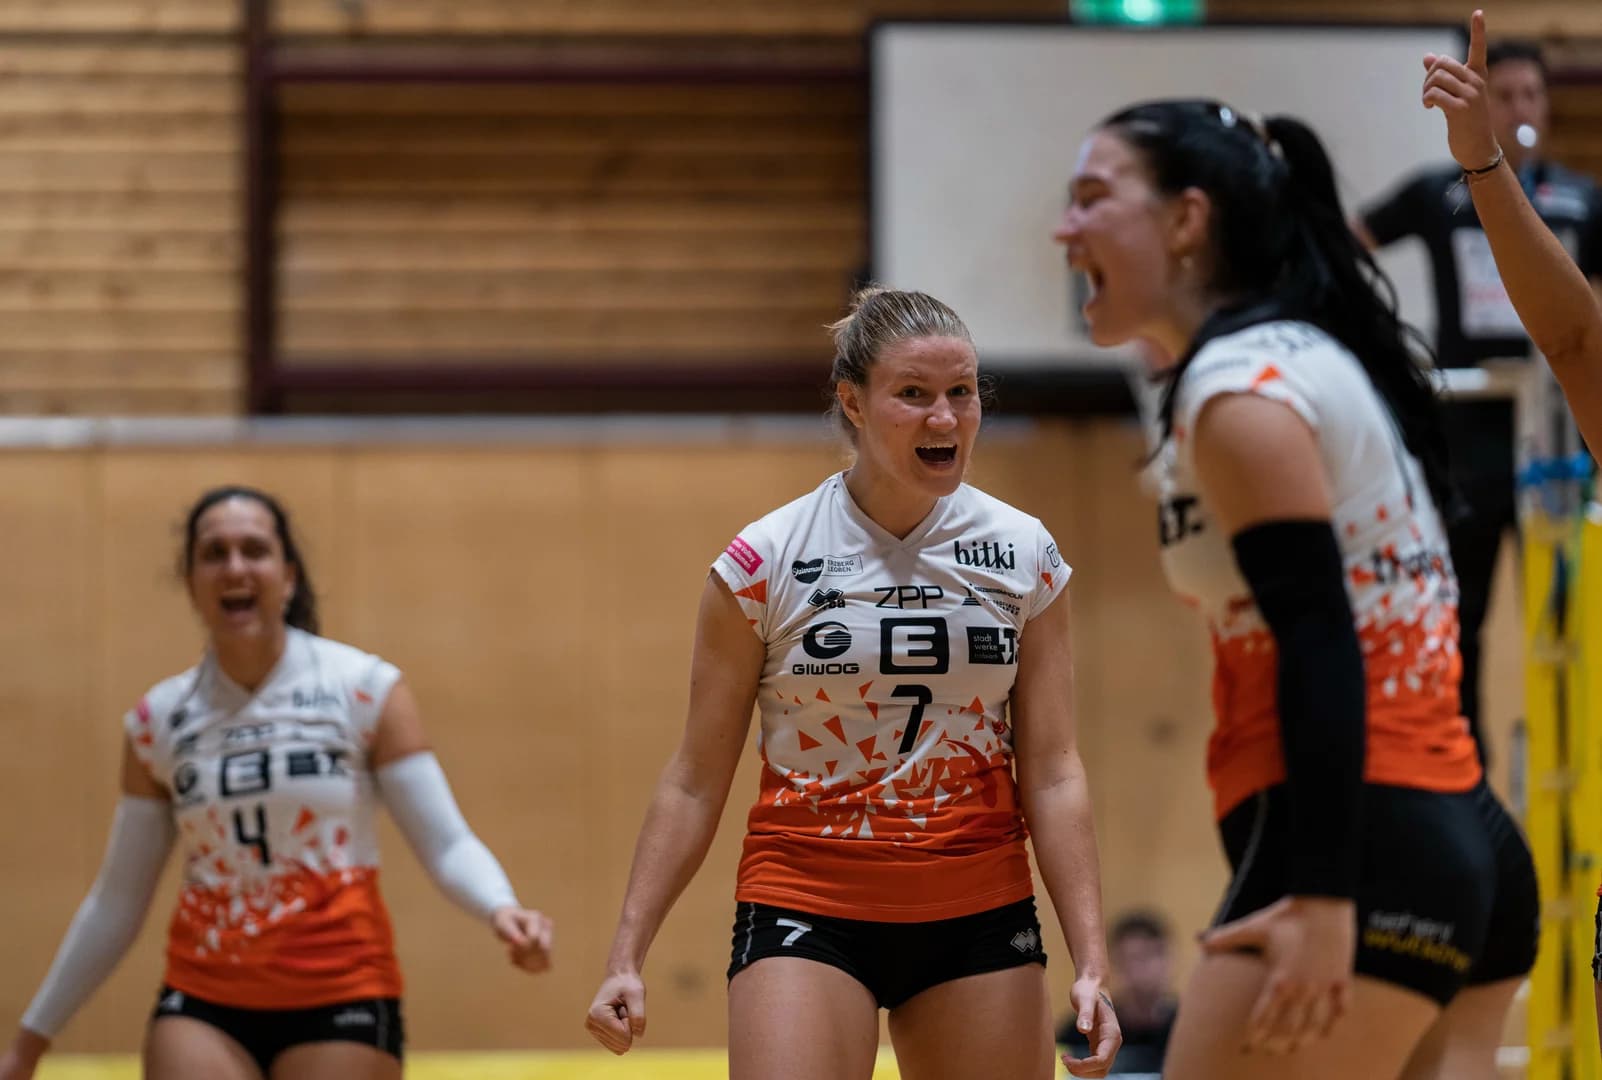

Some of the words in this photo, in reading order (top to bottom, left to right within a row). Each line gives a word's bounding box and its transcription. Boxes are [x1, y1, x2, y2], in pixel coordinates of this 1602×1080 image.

[954, 540, 1016, 570] bitki
[873, 585, 944, 609] ZPP
[973, 633, 993, 642] stadt
[974, 643, 998, 651] werke
[792, 663, 860, 675] GIWOG
[890, 684, 933, 755] 7
[233, 804, 271, 866] 4
[775, 917, 812, 946] 7
